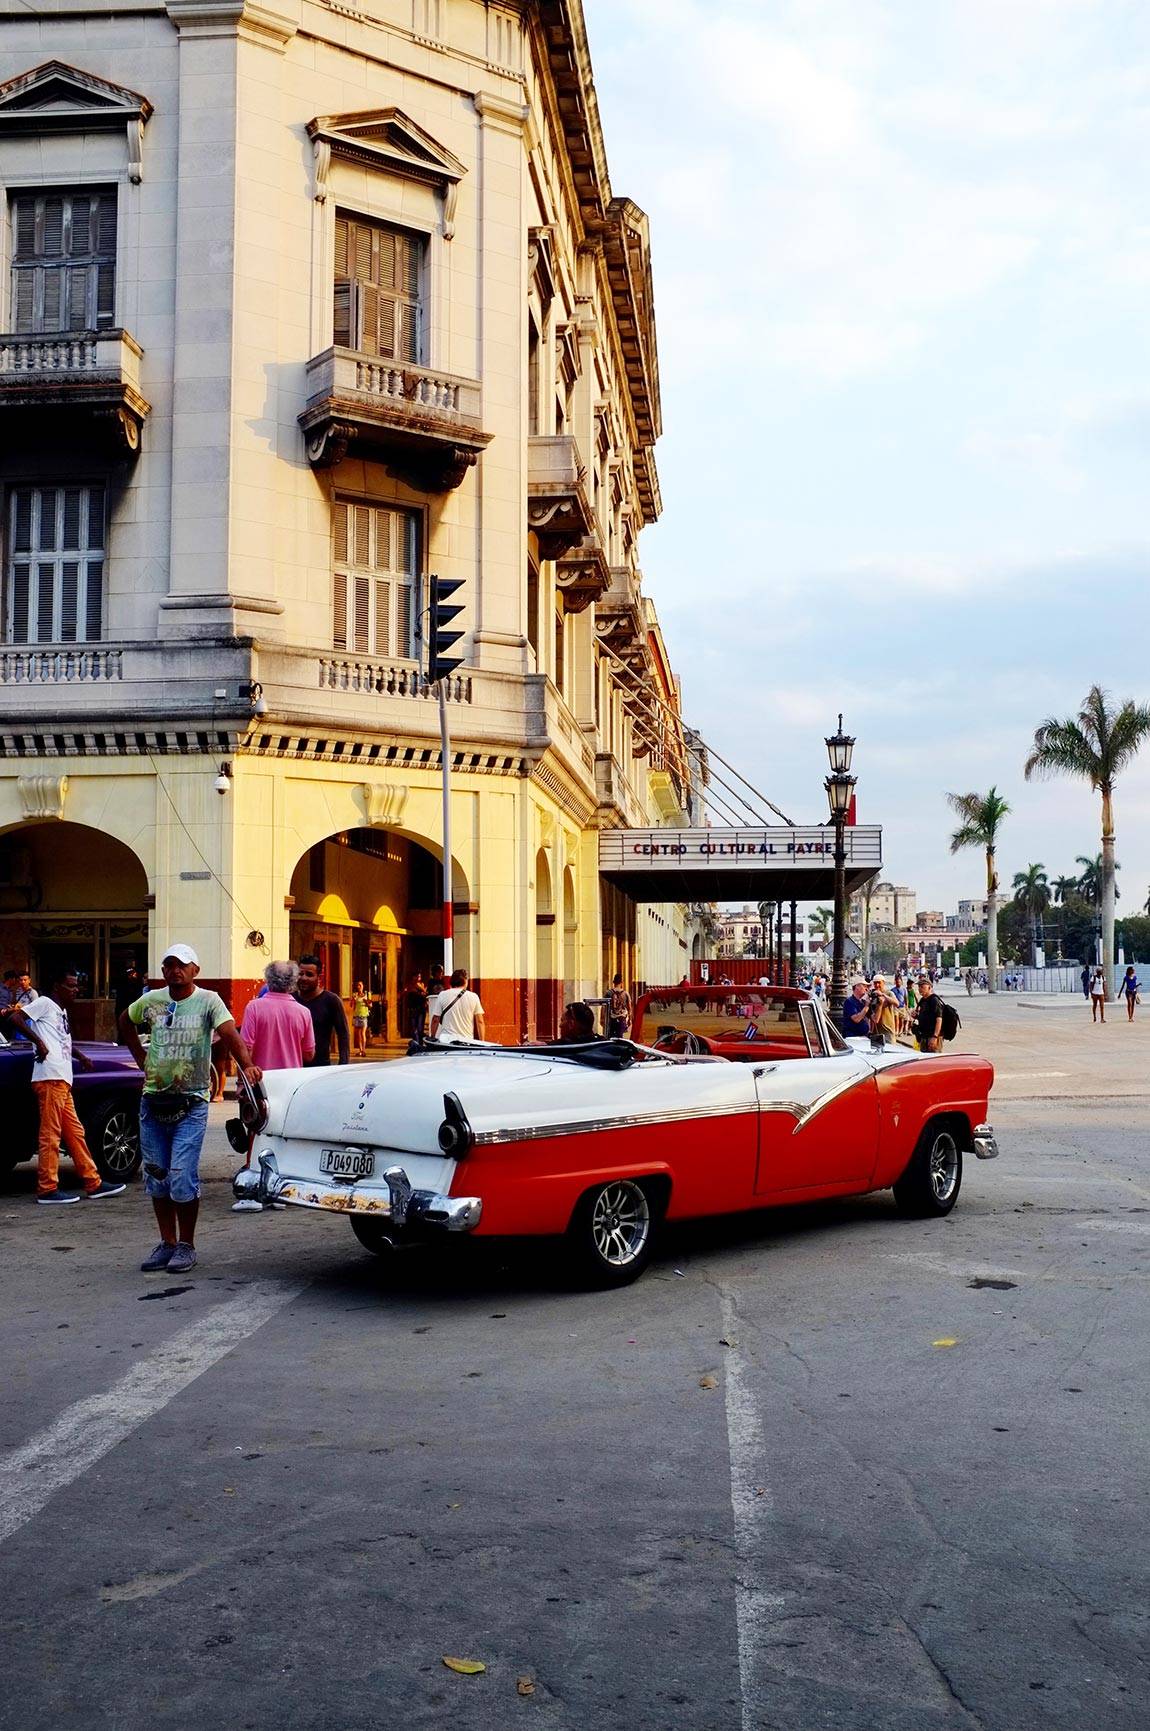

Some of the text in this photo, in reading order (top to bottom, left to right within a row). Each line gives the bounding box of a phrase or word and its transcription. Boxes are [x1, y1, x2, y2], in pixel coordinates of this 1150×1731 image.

[633, 842, 837, 855] CENTRO CULTURAL PAYRE
